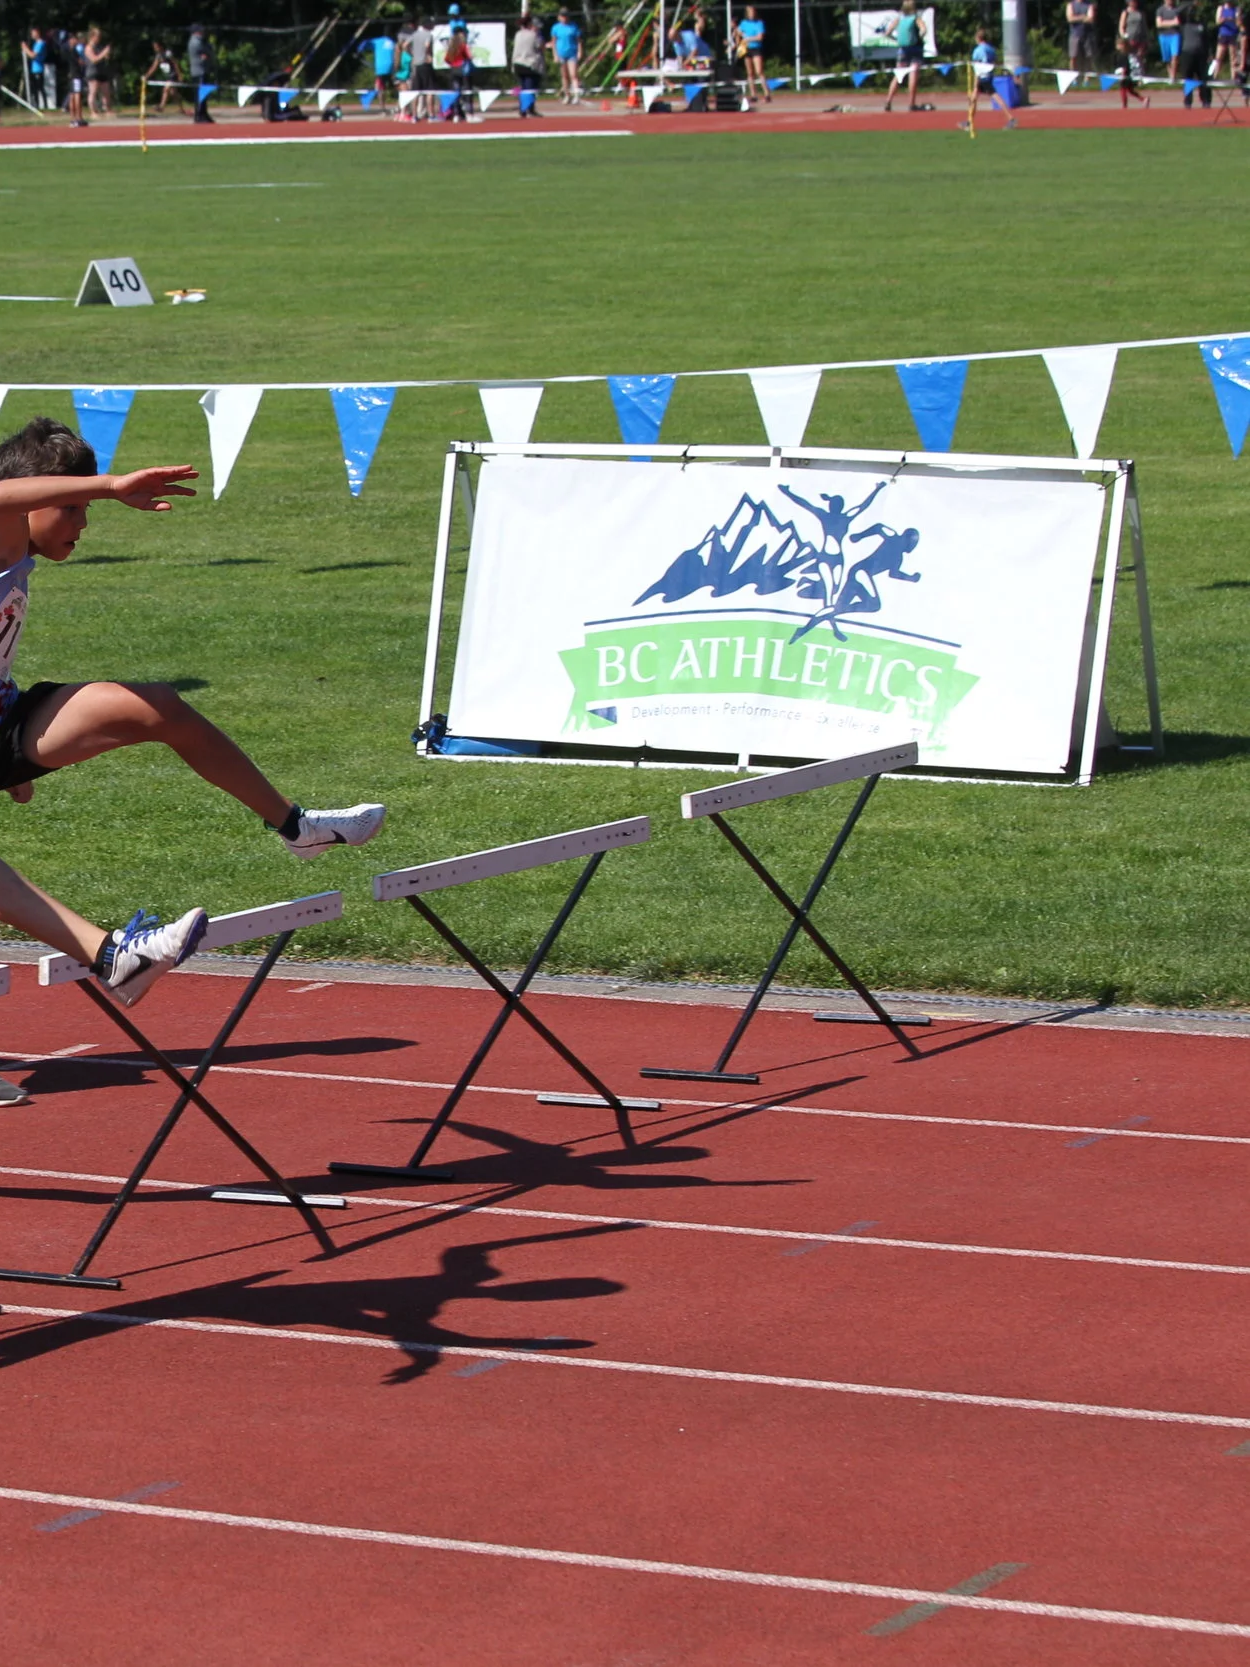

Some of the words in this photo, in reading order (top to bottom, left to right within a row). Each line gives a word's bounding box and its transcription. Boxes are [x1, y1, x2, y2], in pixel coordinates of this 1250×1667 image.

[109, 268, 141, 292] 40
[595, 641, 658, 687] BC
[669, 636, 943, 708] ATHLETICS
[631, 704, 711, 718] Development
